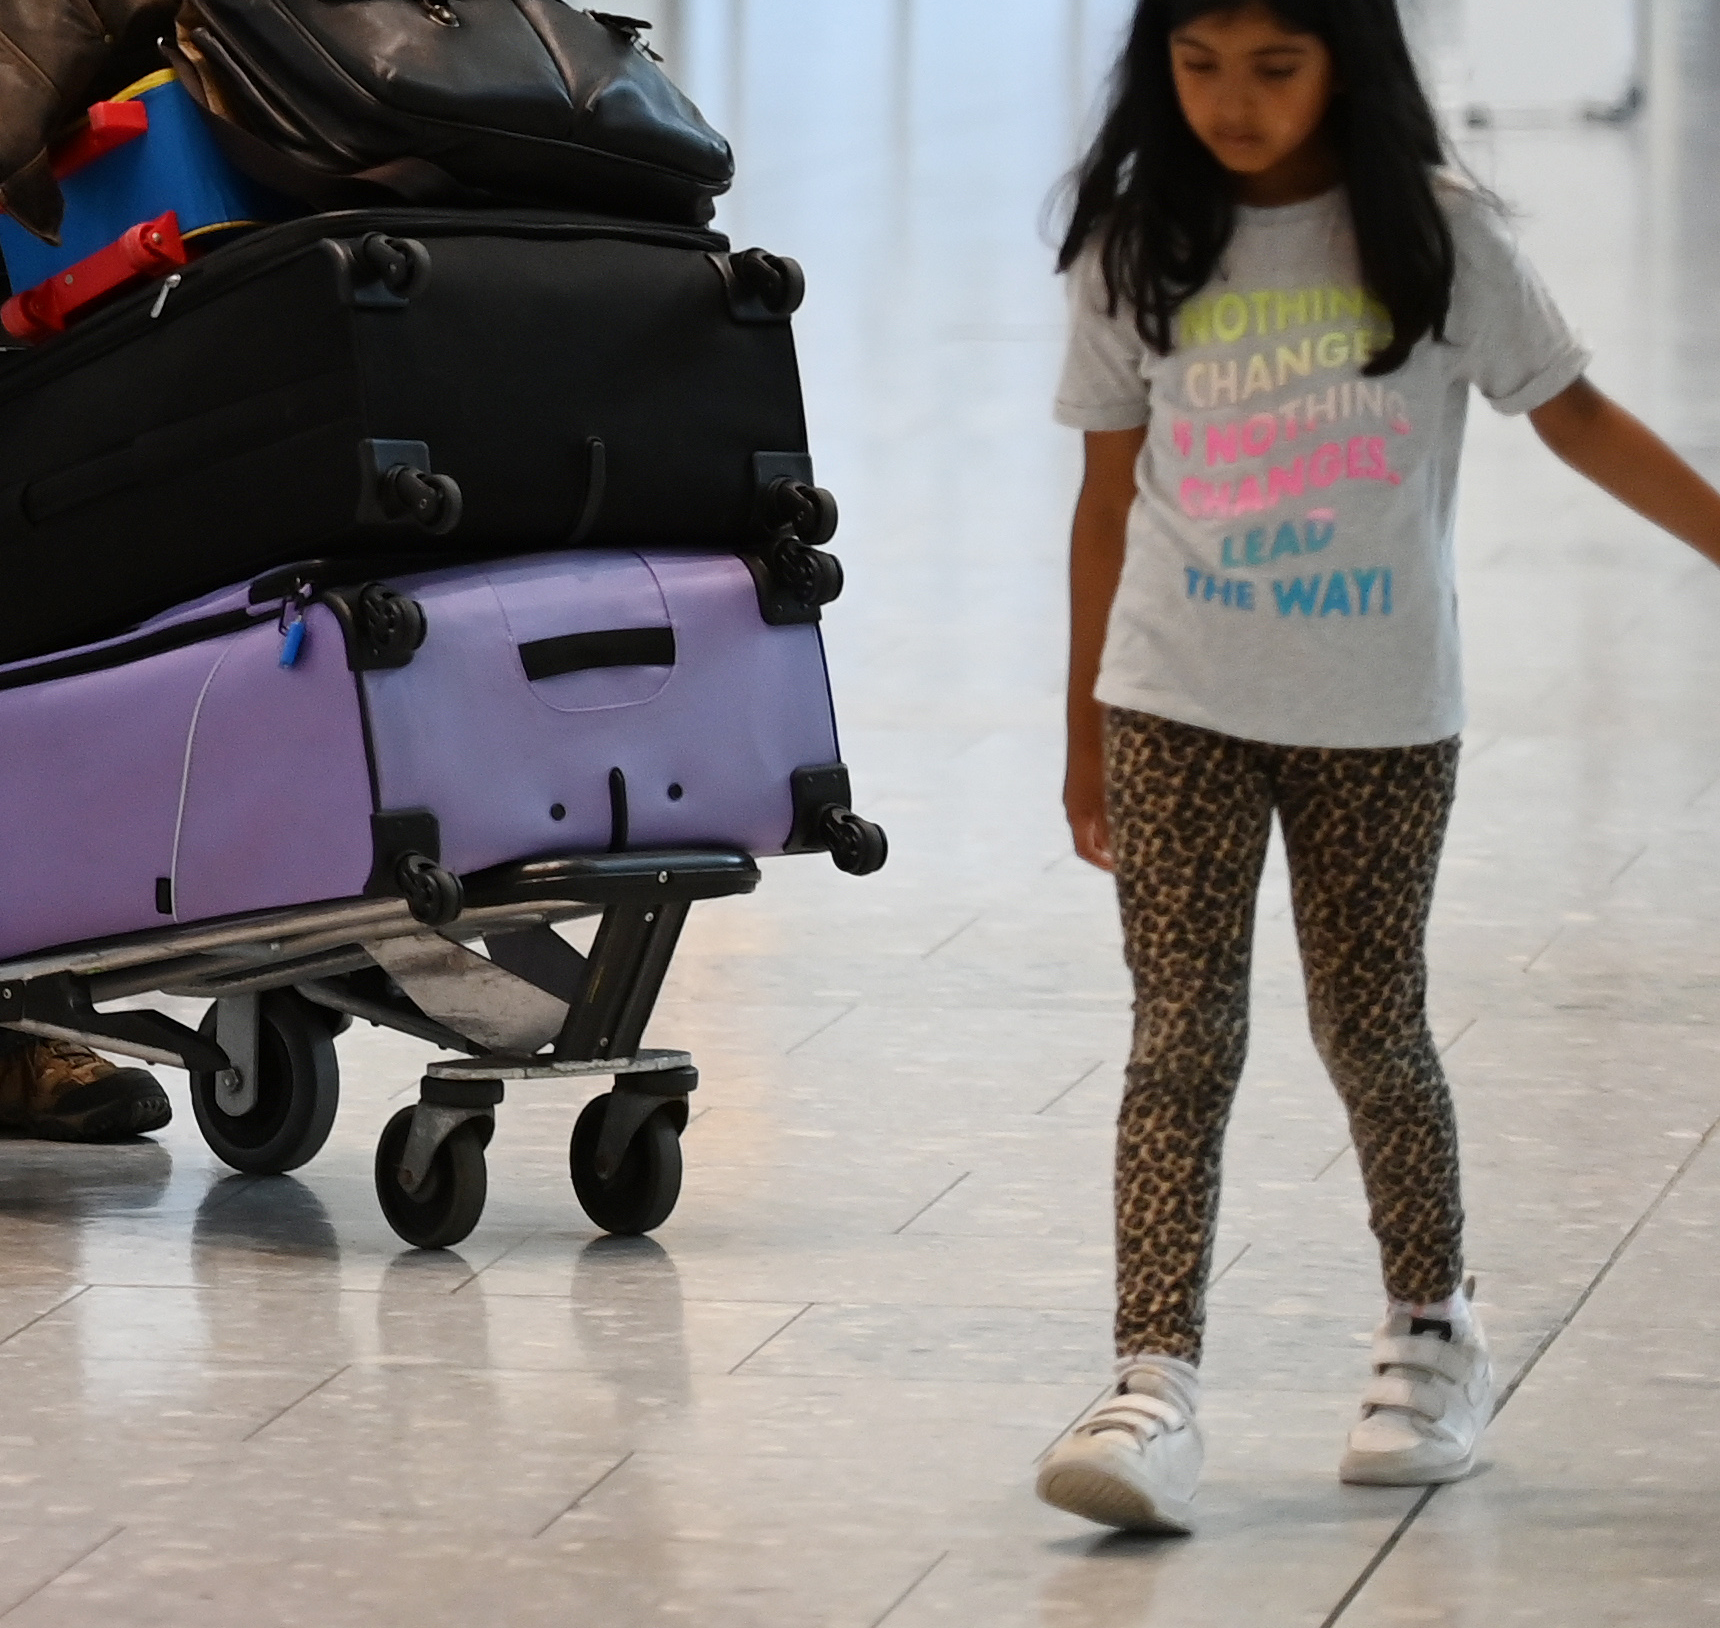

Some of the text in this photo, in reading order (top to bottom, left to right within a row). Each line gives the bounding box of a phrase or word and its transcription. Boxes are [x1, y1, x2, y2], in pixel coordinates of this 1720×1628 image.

[1184, 328, 1388, 410] CHANGE
[1220, 515, 1335, 569] LEAD
[1183, 566, 1255, 612] THE
